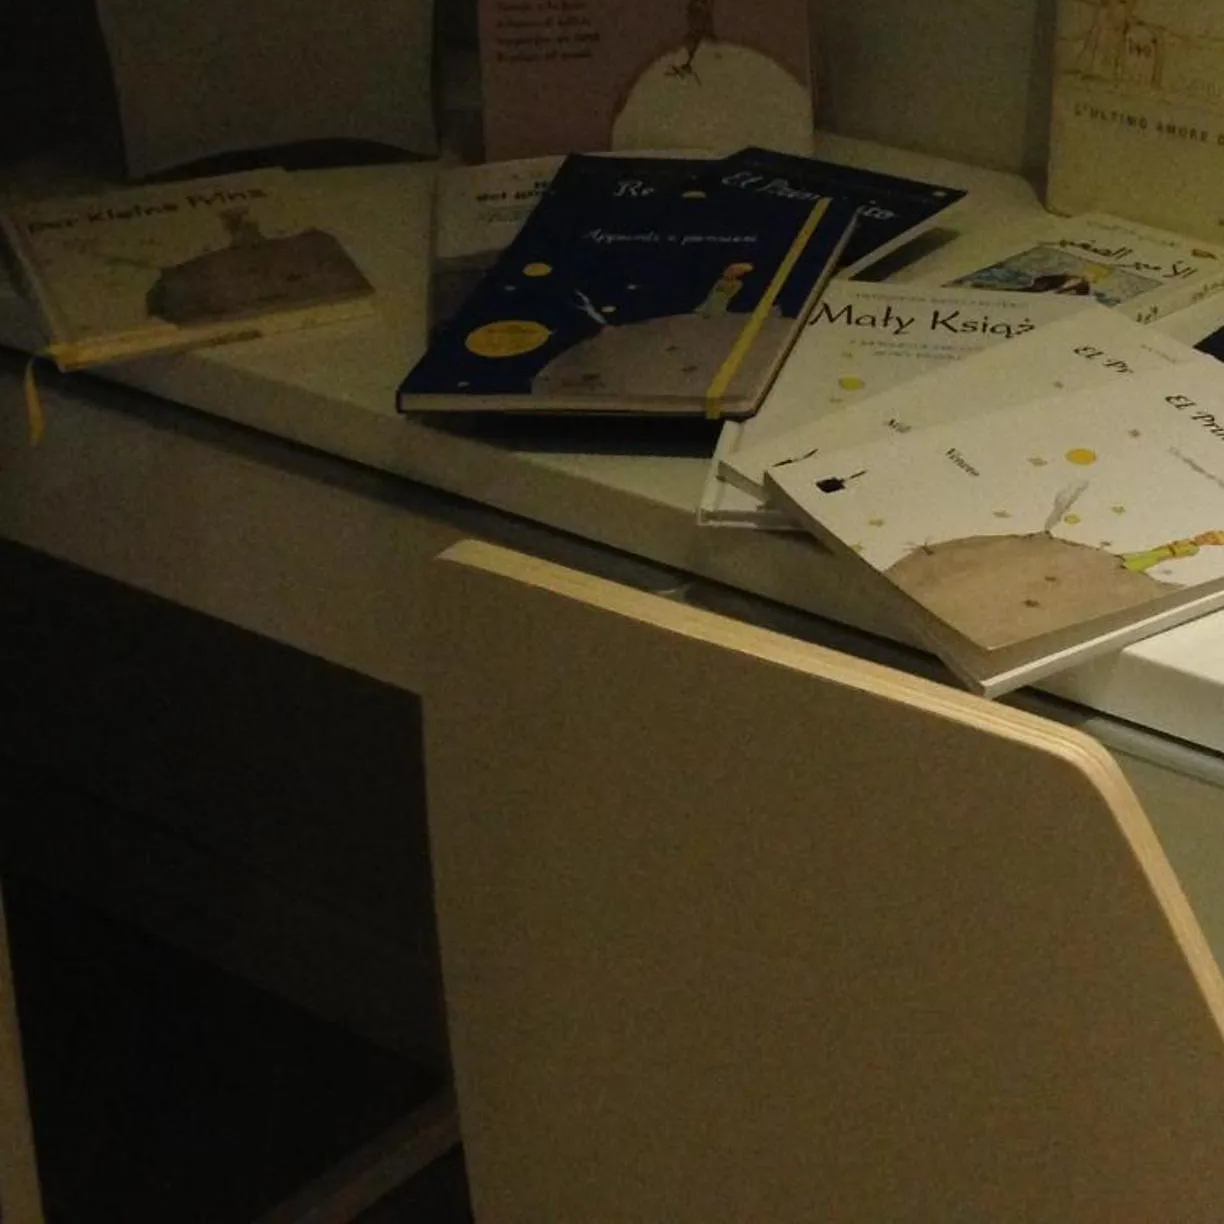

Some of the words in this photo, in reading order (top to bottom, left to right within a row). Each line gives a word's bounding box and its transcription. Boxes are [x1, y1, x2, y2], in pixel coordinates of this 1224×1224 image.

[1073, 102, 1149, 130] L'ULTIMO
[1154, 120, 1209, 143] AMORE
[807, 302, 915, 336] Mały
[1164, 394, 1197, 411] El
